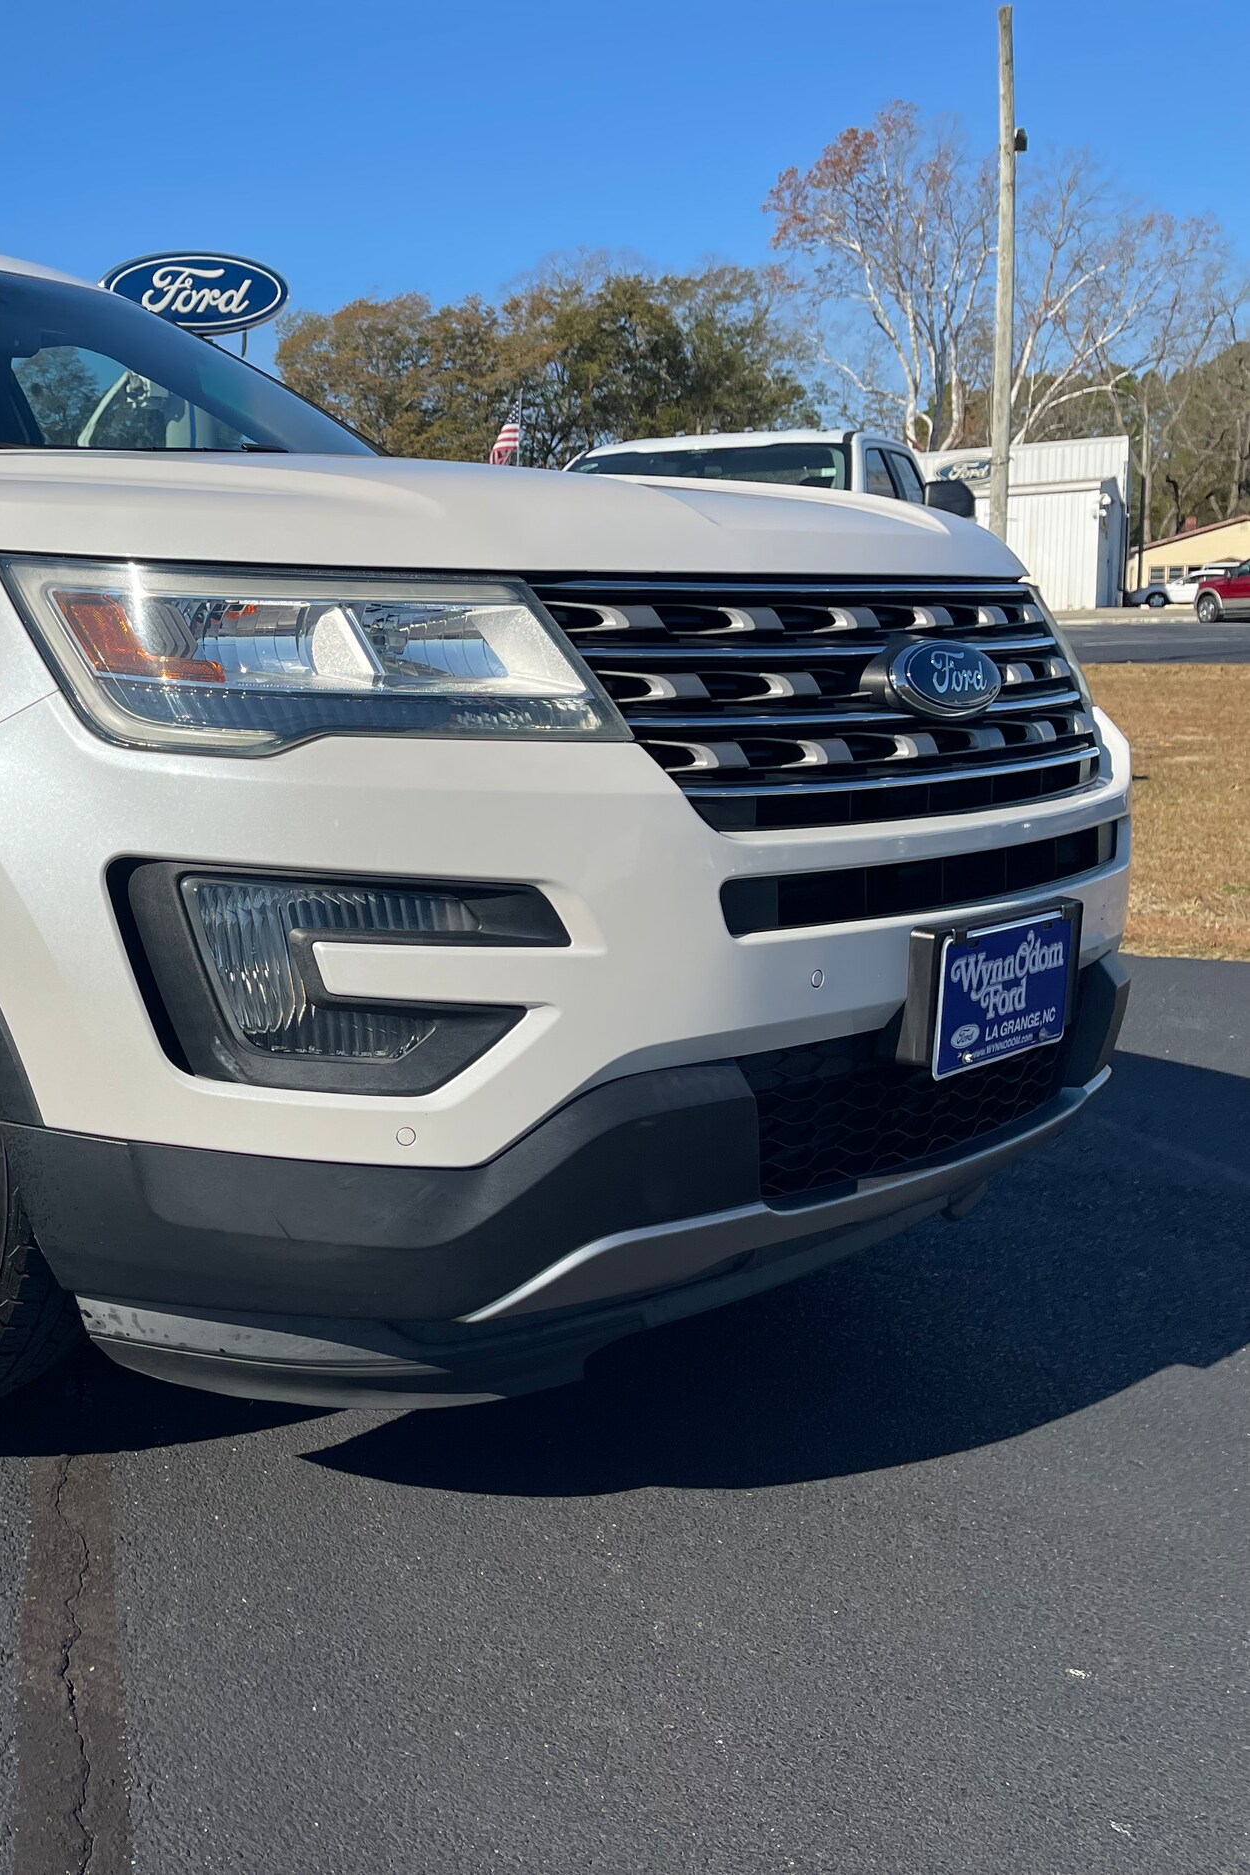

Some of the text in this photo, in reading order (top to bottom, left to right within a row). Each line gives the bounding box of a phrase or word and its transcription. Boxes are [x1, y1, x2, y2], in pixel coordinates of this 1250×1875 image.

[141, 265, 253, 314] Ford
[948, 461, 989, 481] Ford
[931, 650, 988, 694] Ford
[980, 974, 1027, 1021] Ford
[984, 1023, 999, 1042] LA
